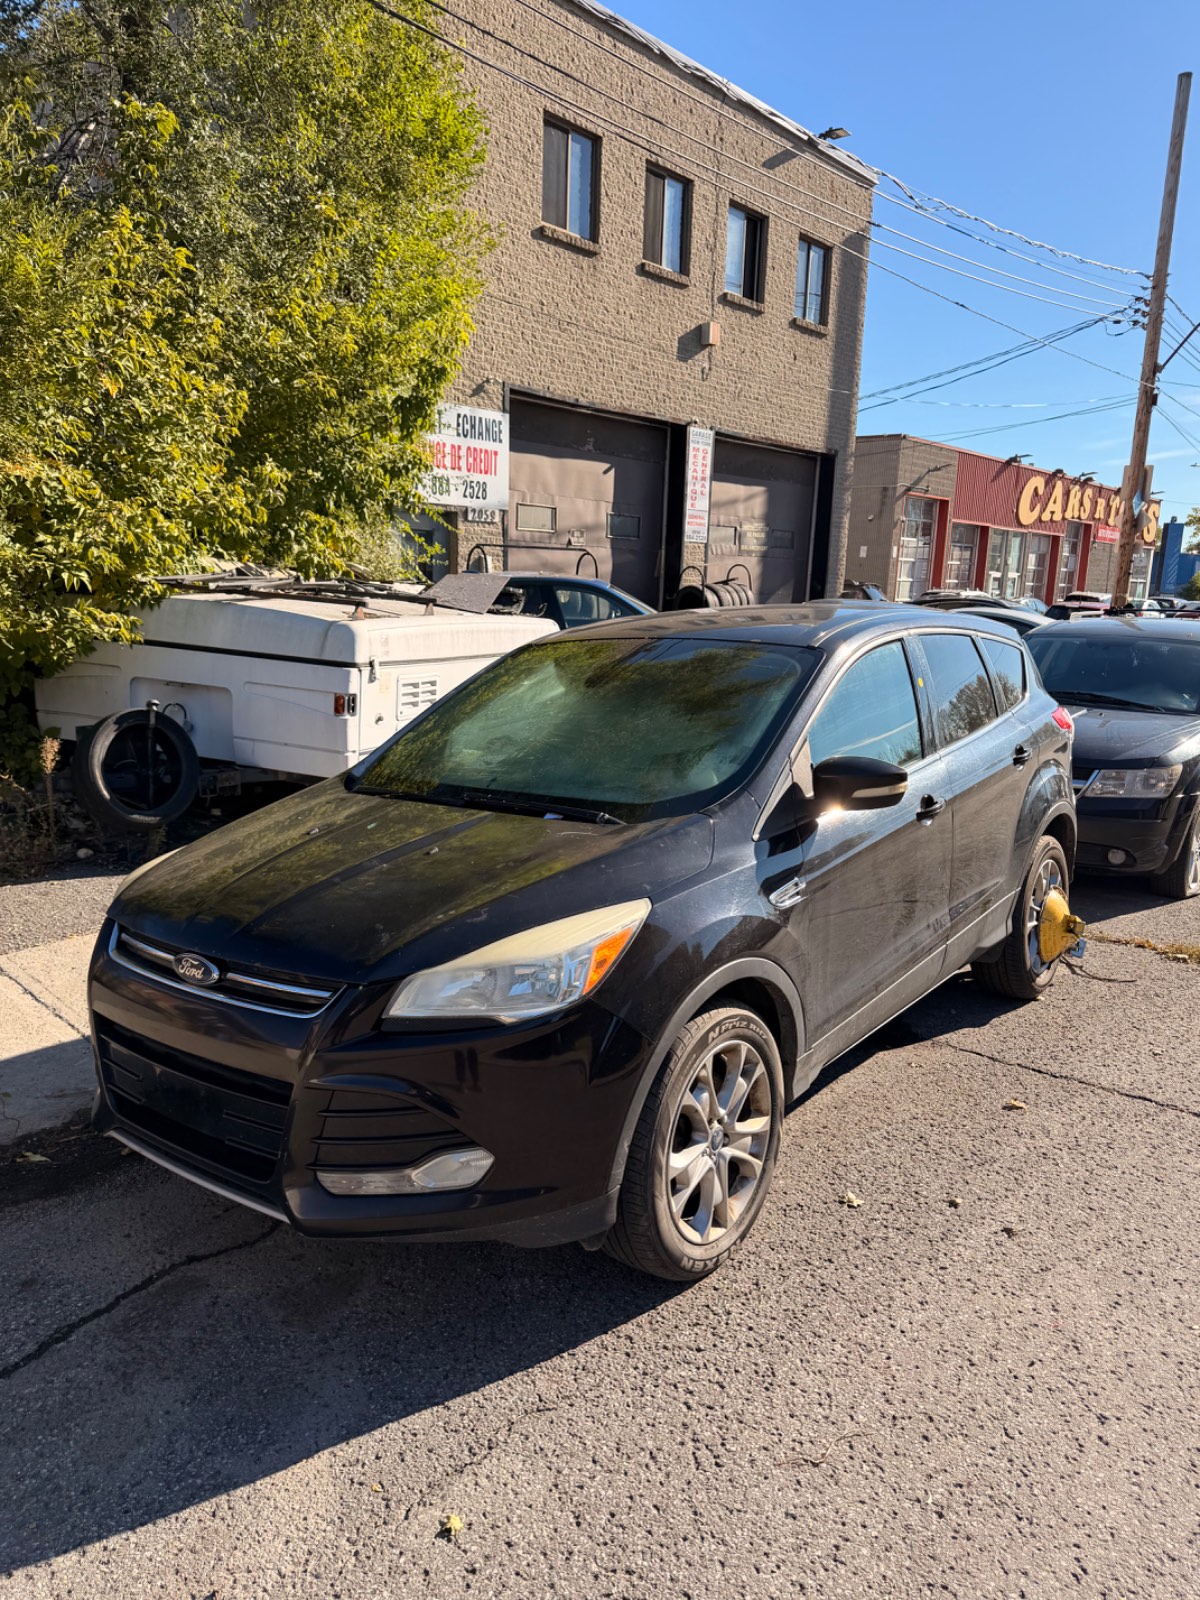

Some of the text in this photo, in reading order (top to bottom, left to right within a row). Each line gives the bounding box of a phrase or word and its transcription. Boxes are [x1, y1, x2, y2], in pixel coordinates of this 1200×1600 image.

[456, 413, 503, 444] ECHANGE
[450, 444, 462, 472] DE
[465, 446, 499, 476] CREDIT
[462, 480, 488, 500] 2528
[1018, 476, 1160, 542] CARS R TS
[178, 957, 205, 979] Ford
